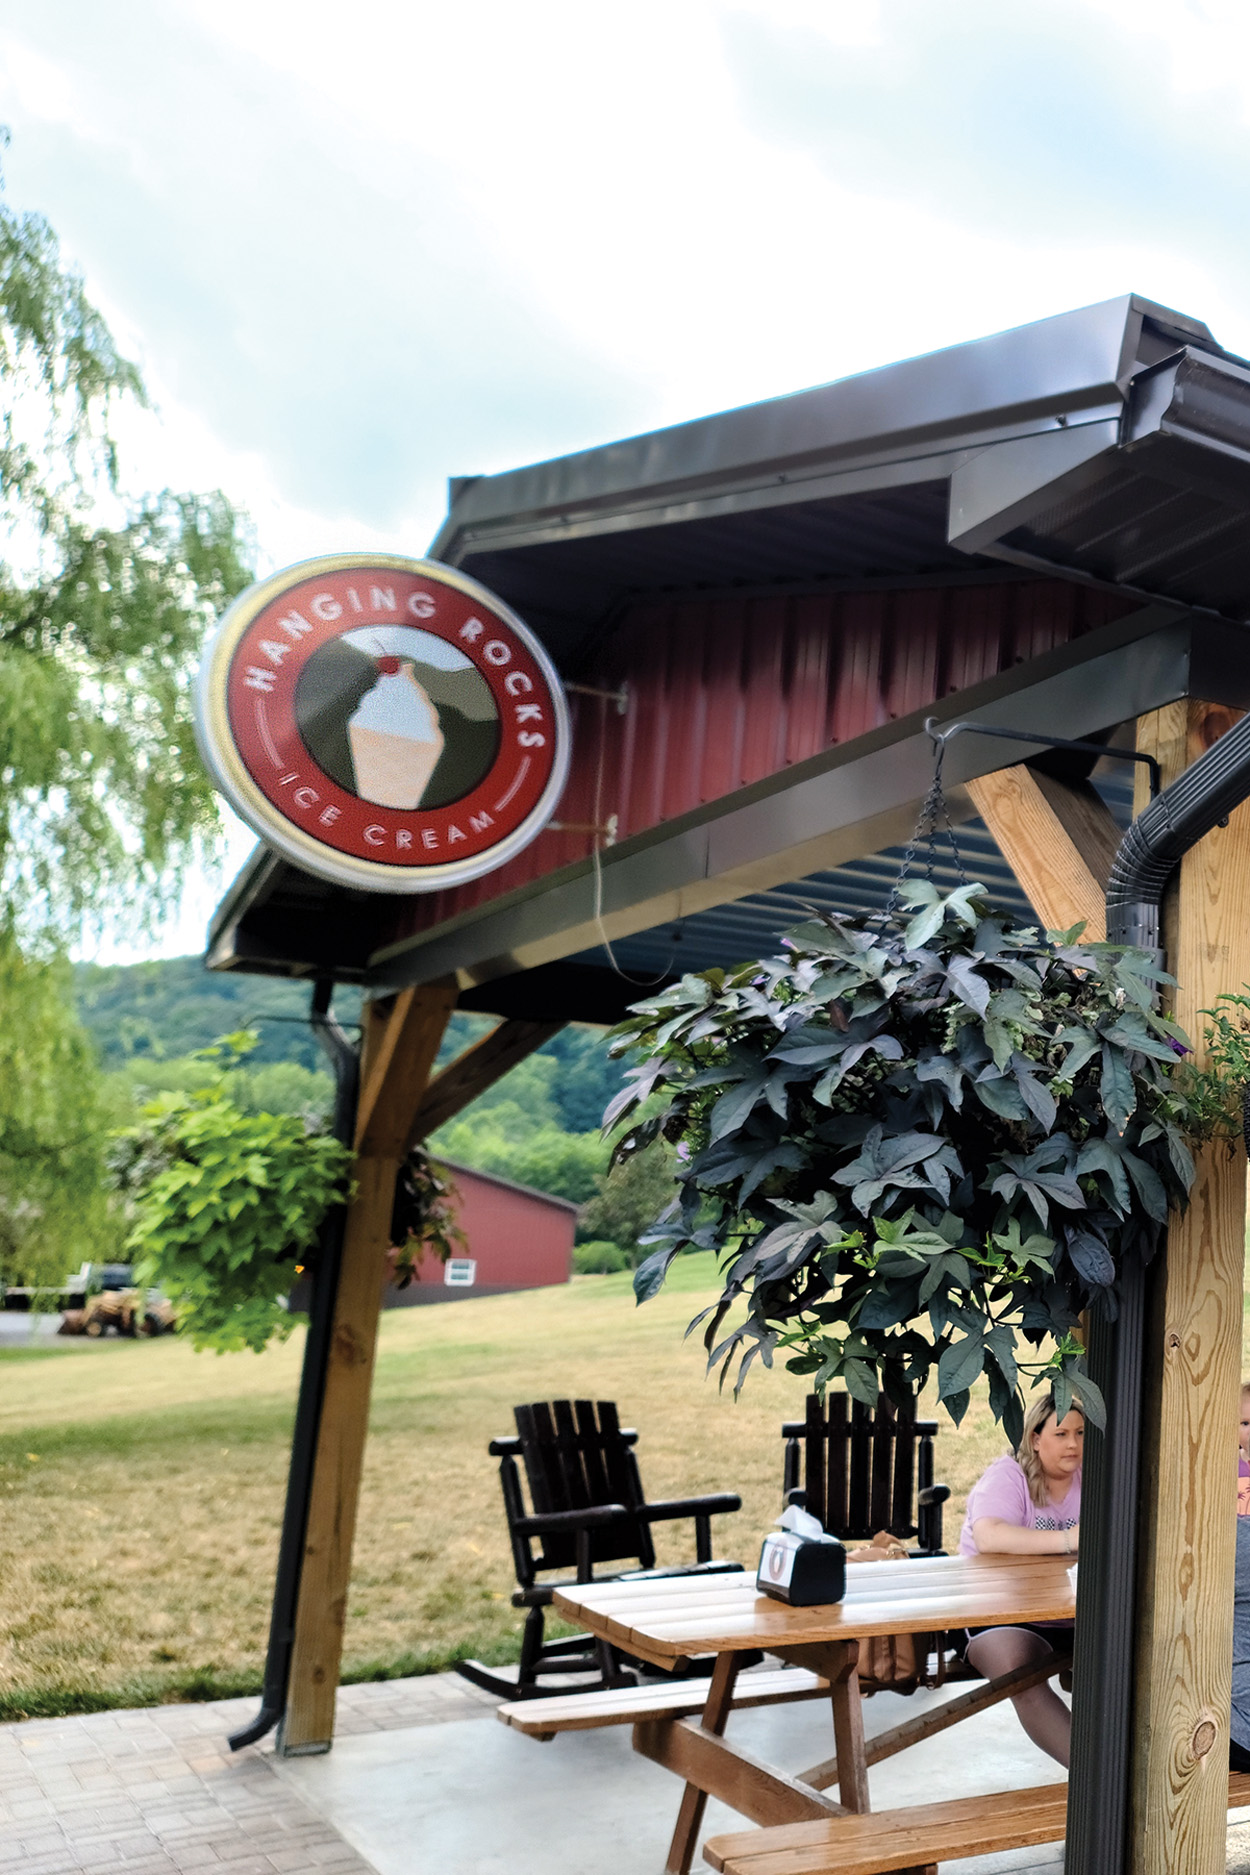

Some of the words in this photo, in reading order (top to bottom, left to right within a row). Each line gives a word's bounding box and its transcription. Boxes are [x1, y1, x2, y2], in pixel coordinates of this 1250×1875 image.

[244, 586, 437, 693] HANGING
[459, 616, 546, 749] ROCKS
[278, 772, 343, 827] ICE
[362, 810, 495, 850] CREAM
